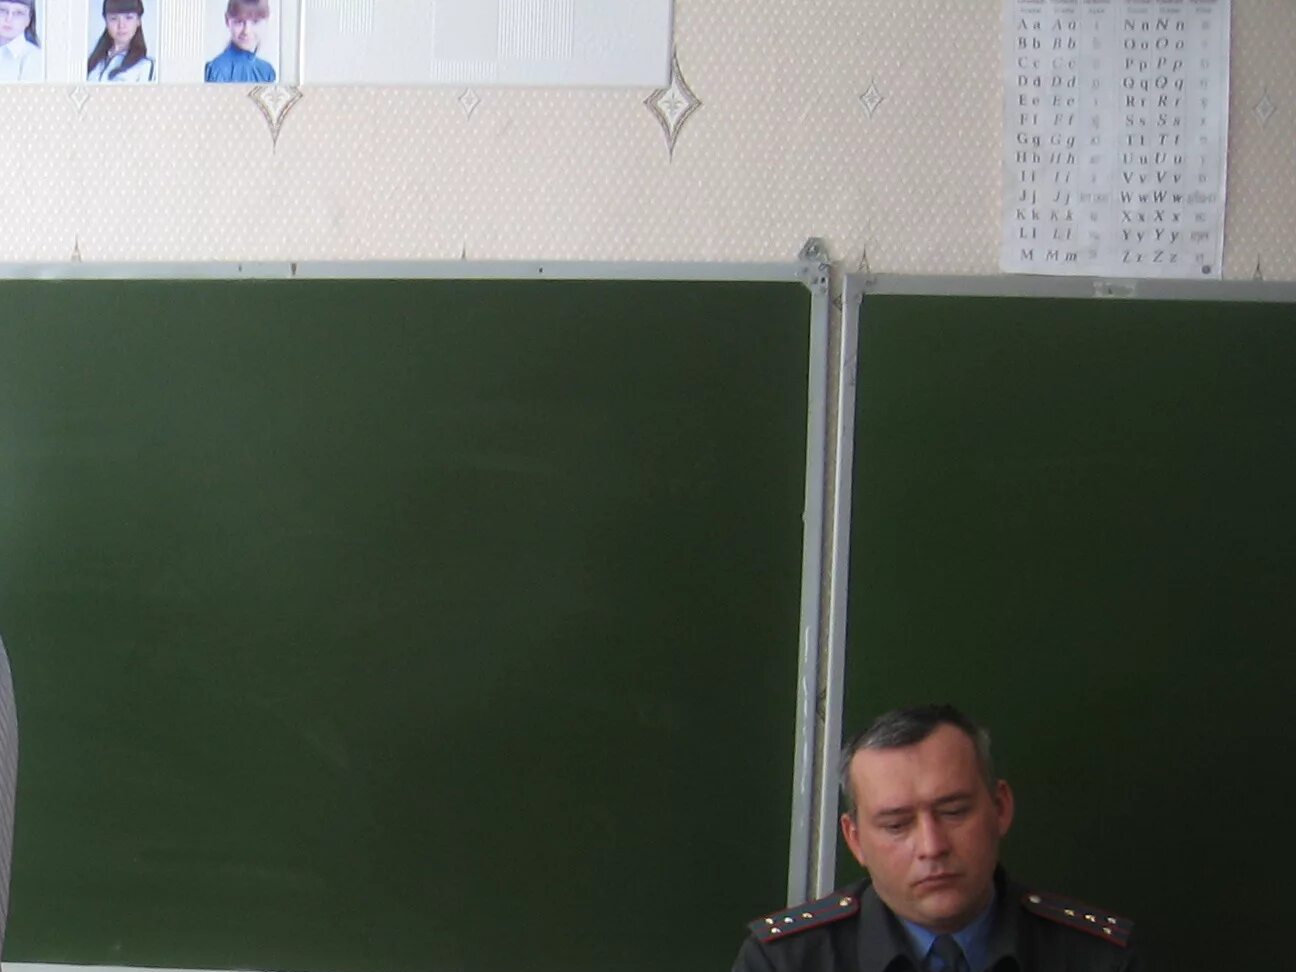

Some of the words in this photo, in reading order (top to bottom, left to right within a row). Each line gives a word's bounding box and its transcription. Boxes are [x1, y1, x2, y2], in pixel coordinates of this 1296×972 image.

[1124, 19, 1135, 31] N
[1156, 18, 1169, 31] N
[1032, 37, 1041, 49] b
[1067, 36, 1076, 49] b
[1139, 60, 1148, 72] p
[1172, 60, 1183, 72] p
[1018, 75, 1028, 87] D
[1032, 75, 1041, 88] d
[1066, 75, 1076, 88] d
[1140, 79, 1149, 92] q
[1174, 79, 1184, 91] q
[1017, 132, 1028, 144] G
[1066, 152, 1076, 164] h
[1020, 249, 1034, 261] M
[1046, 249, 1059, 261] M
[1065, 253, 1078, 261] m
